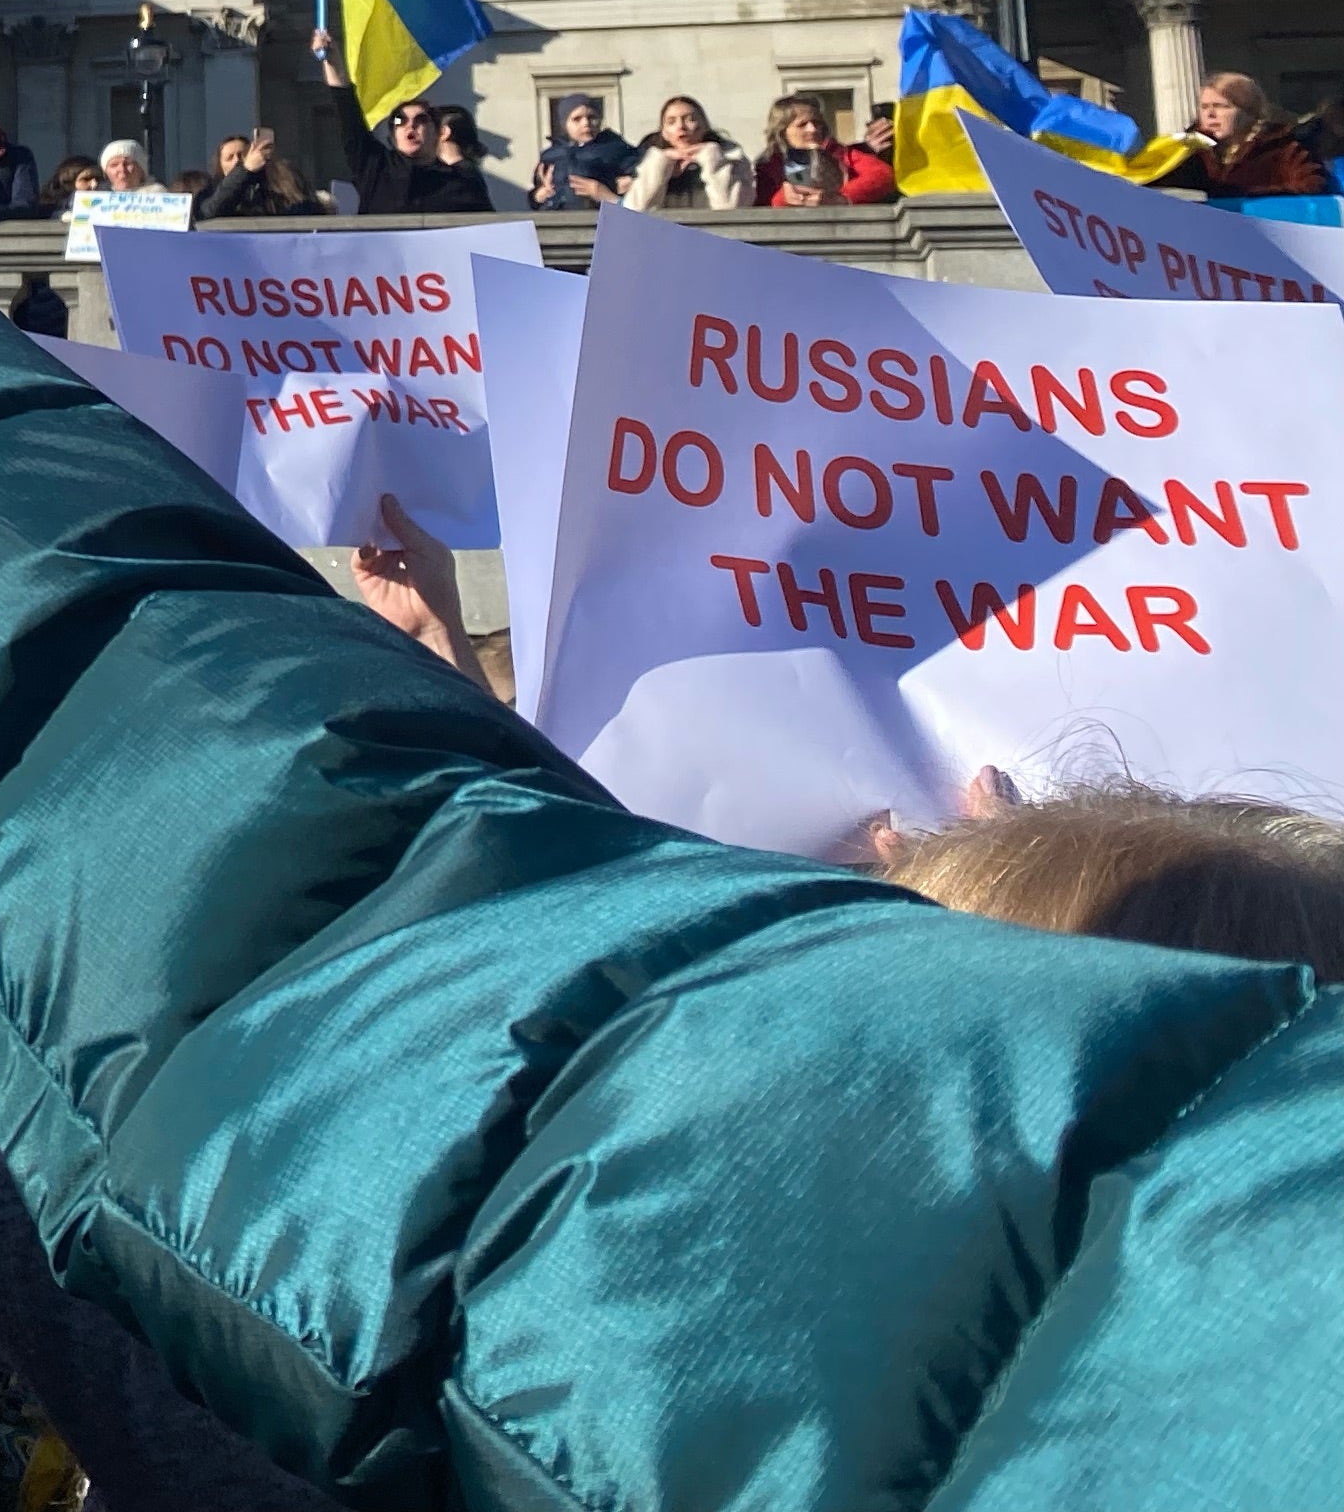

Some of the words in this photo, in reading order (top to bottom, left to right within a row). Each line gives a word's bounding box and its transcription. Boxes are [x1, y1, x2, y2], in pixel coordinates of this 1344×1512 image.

[1034, 189, 1146, 275] STOP
[190, 271, 452, 319] RUSSIANS
[162, 334, 232, 372] DO
[241, 339, 342, 377] NOT
[354, 332, 483, 378] WAN
[689, 313, 1180, 439] RUSSIANS
[245, 389, 354, 436] THE
[352, 387, 471, 433] WAR
[607, 416, 724, 507] DO
[753, 443, 953, 538] NOT
[981, 469, 1310, 552] WANT
[710, 554, 915, 649] THE
[935, 580, 1212, 656] WAR
